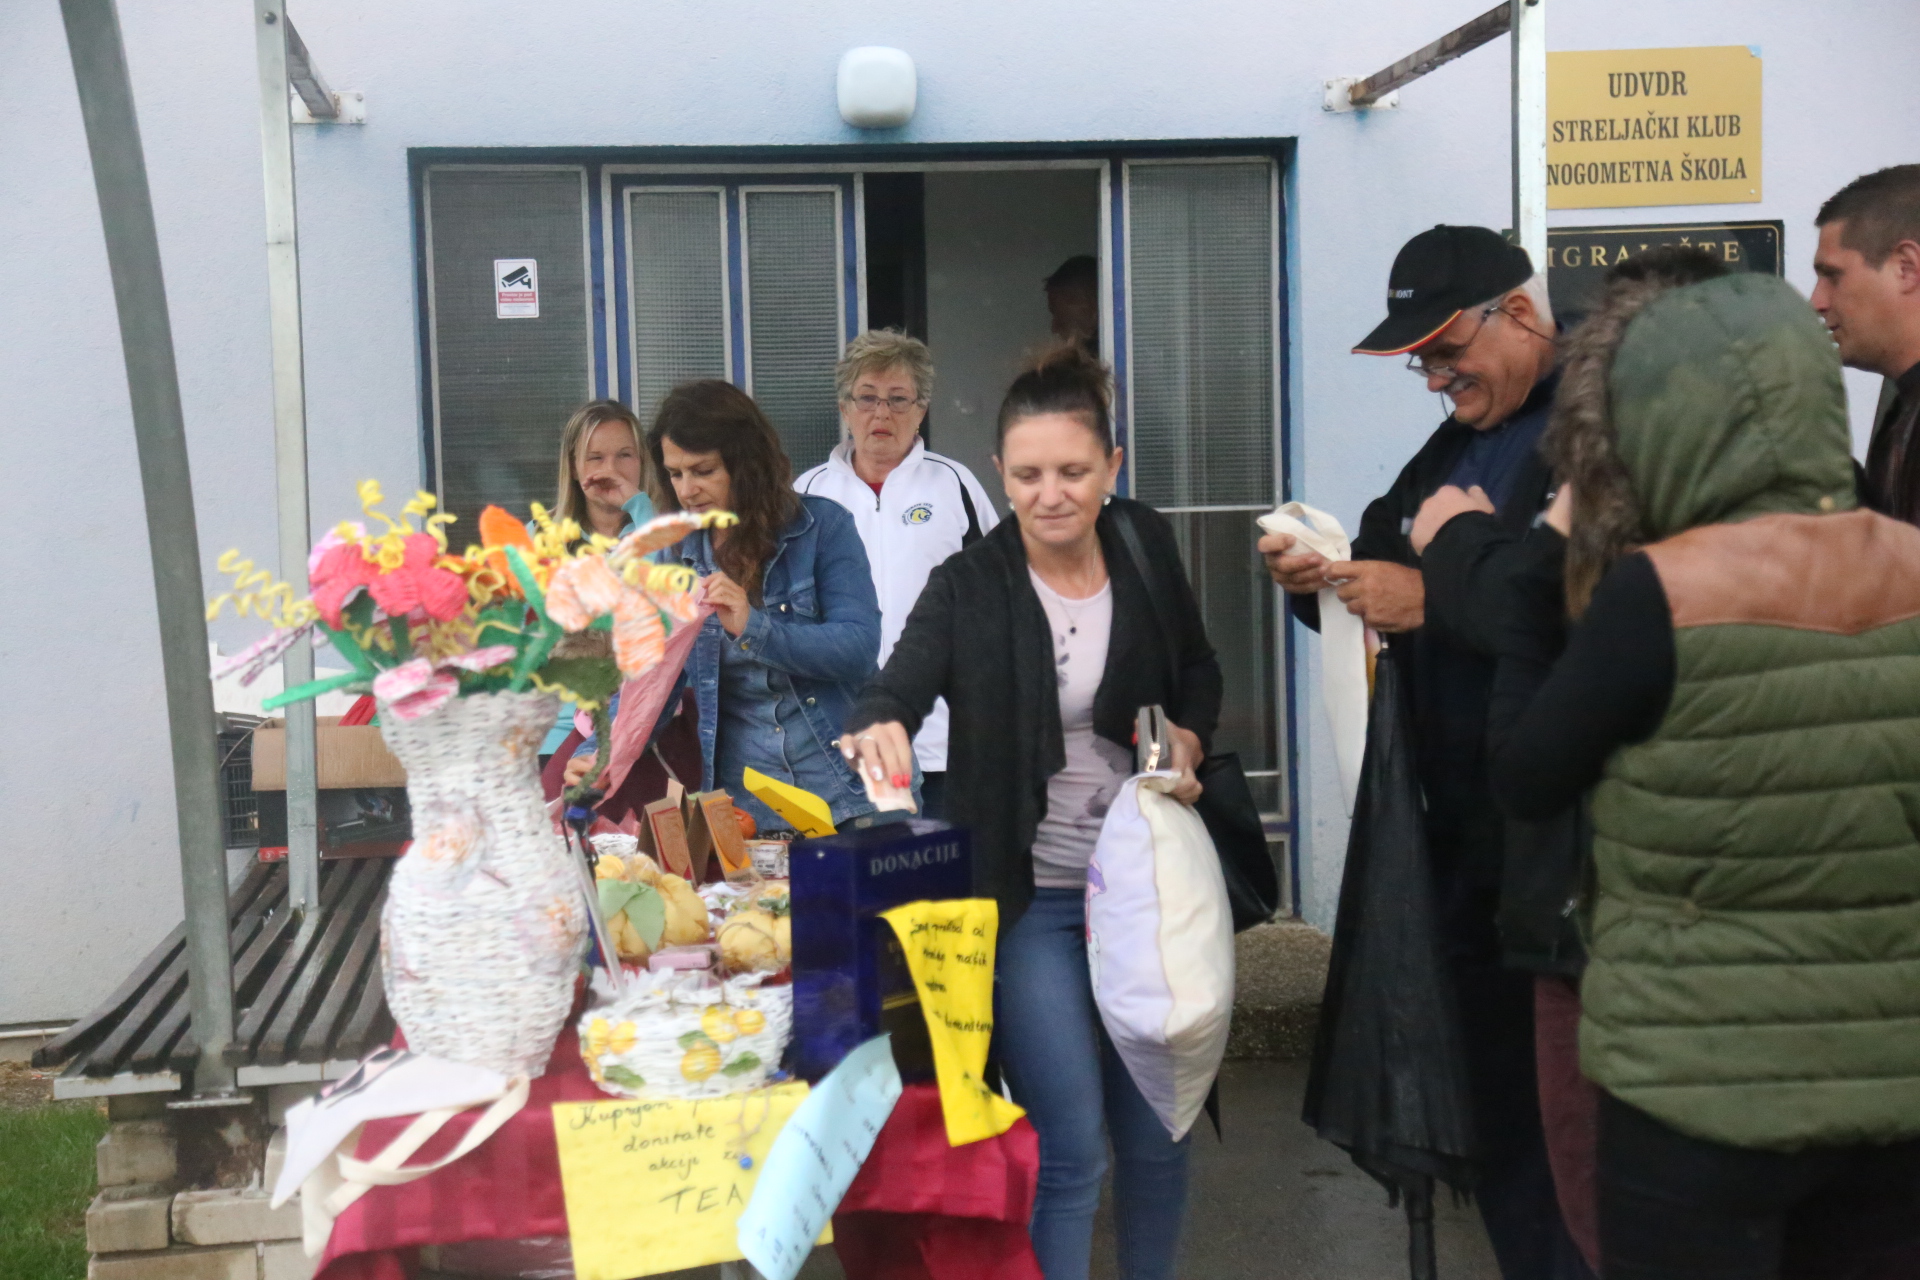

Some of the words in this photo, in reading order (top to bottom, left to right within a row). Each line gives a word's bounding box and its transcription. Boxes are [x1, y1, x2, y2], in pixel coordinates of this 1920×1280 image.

[1608, 71, 1688, 98] UDVDR
[1552, 110, 1680, 142] STRELJAČKI
[1687, 115, 1742, 138] KLUB
[1547, 160, 1674, 186] NOGOMETNA
[1681, 152, 1748, 181] ŠKOLA
[870, 842, 960, 876] DONACIJE
